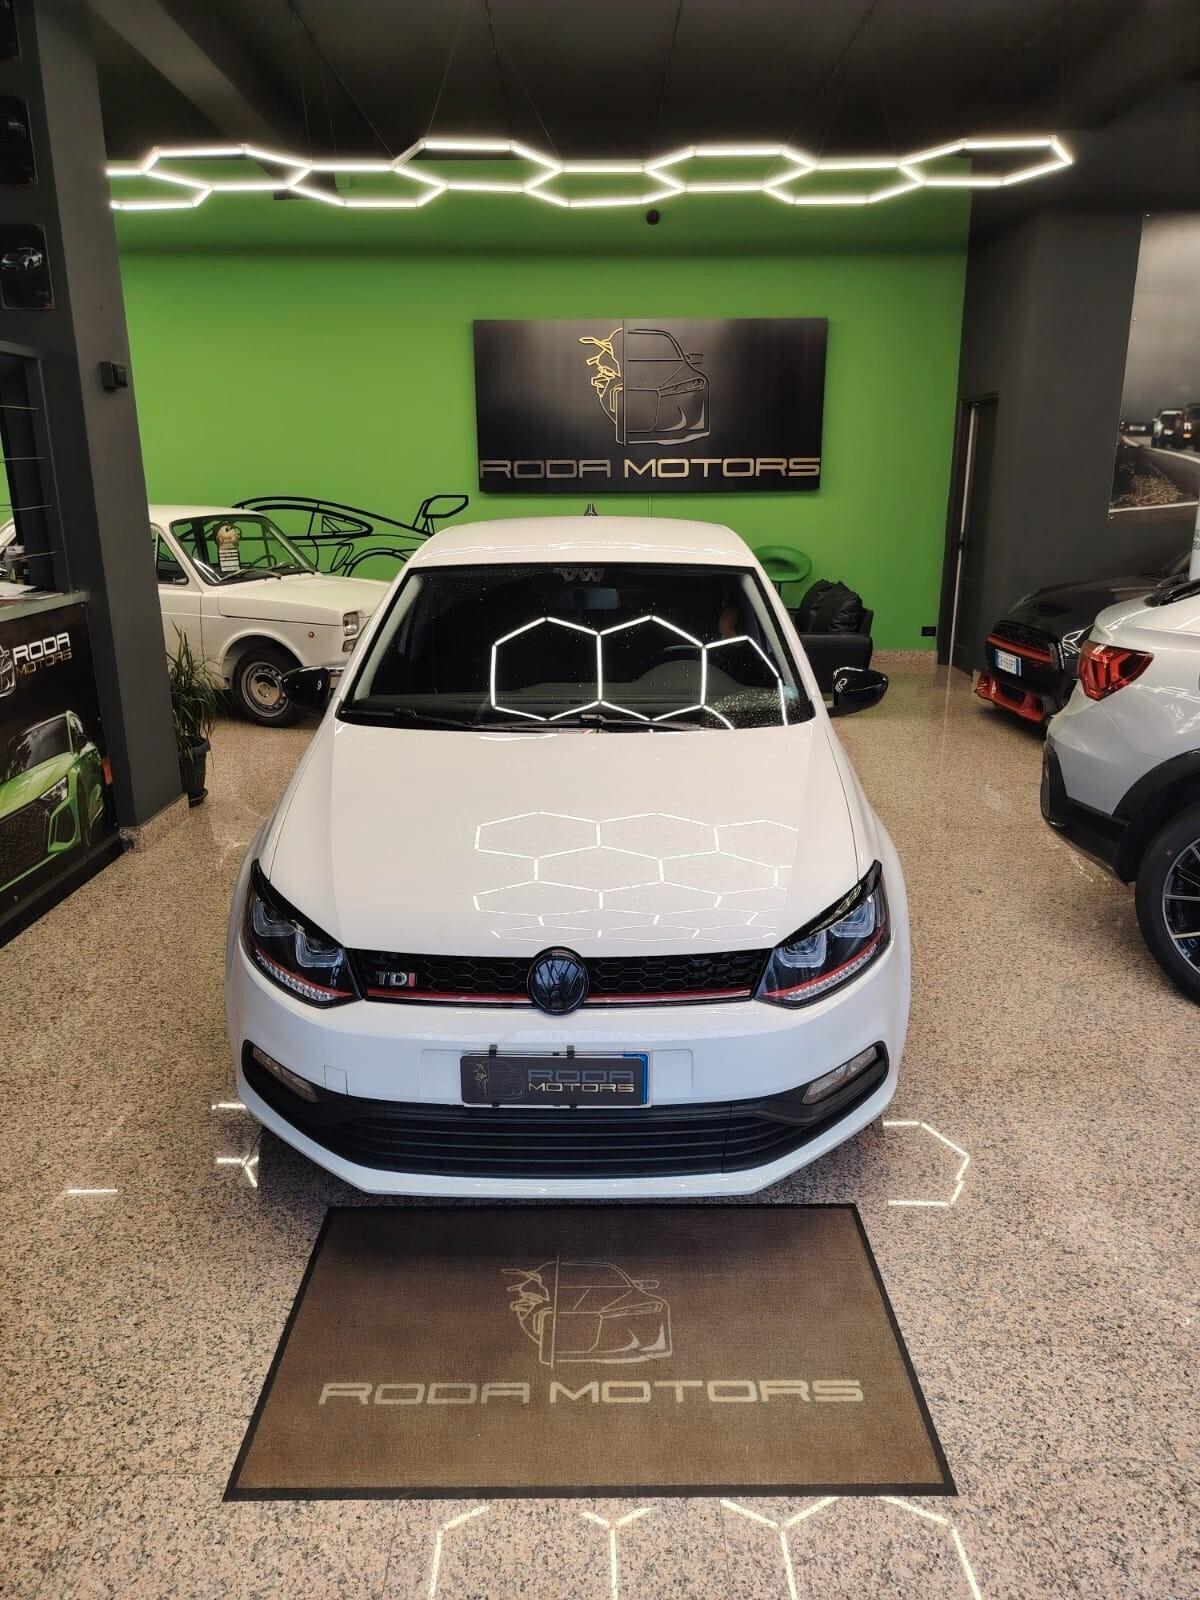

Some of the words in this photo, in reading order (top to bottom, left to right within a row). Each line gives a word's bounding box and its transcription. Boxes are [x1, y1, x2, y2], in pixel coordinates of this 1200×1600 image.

[479, 459, 611, 479] RODA
[624, 457, 820, 479] MOTORS
[12, 632, 71, 666] RODA
[16, 648, 72, 676] MOTORS
[375, 970, 416, 988] TDI
[527, 1069, 634, 1083] RODA
[528, 1083, 635, 1093] MOTORS
[318, 1382, 531, 1406] RODA
[548, 1380, 864, 1405] MOTORS
